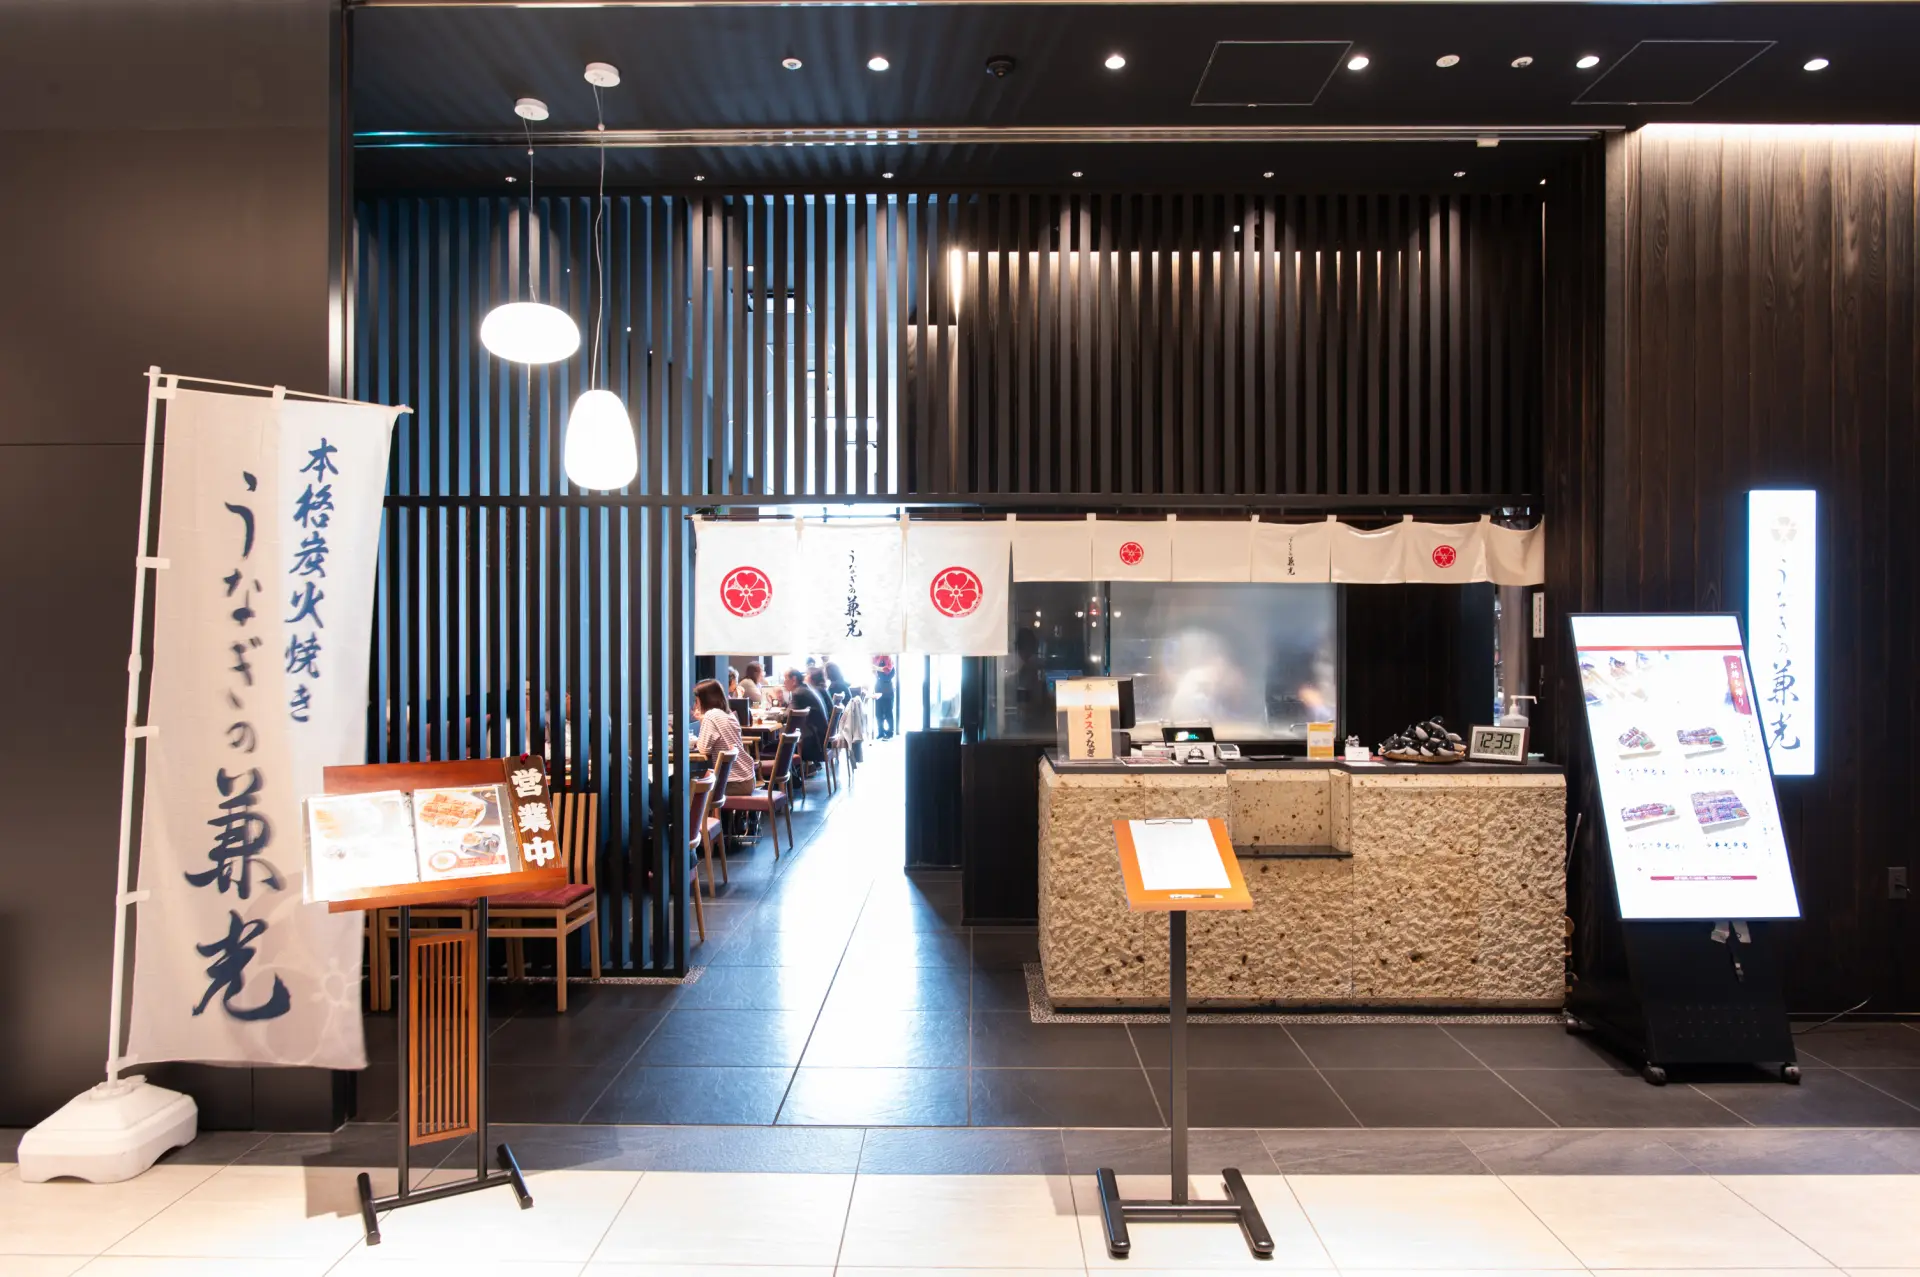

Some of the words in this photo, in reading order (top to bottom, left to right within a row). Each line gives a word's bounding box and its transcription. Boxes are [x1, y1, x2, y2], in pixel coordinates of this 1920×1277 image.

[284, 437, 339, 724] 本格炭火焼き
[184, 471, 291, 1021] うなぎの兼光
[511, 767, 555, 867] 営業中
[1480, 732, 1514, 750] 12:39
